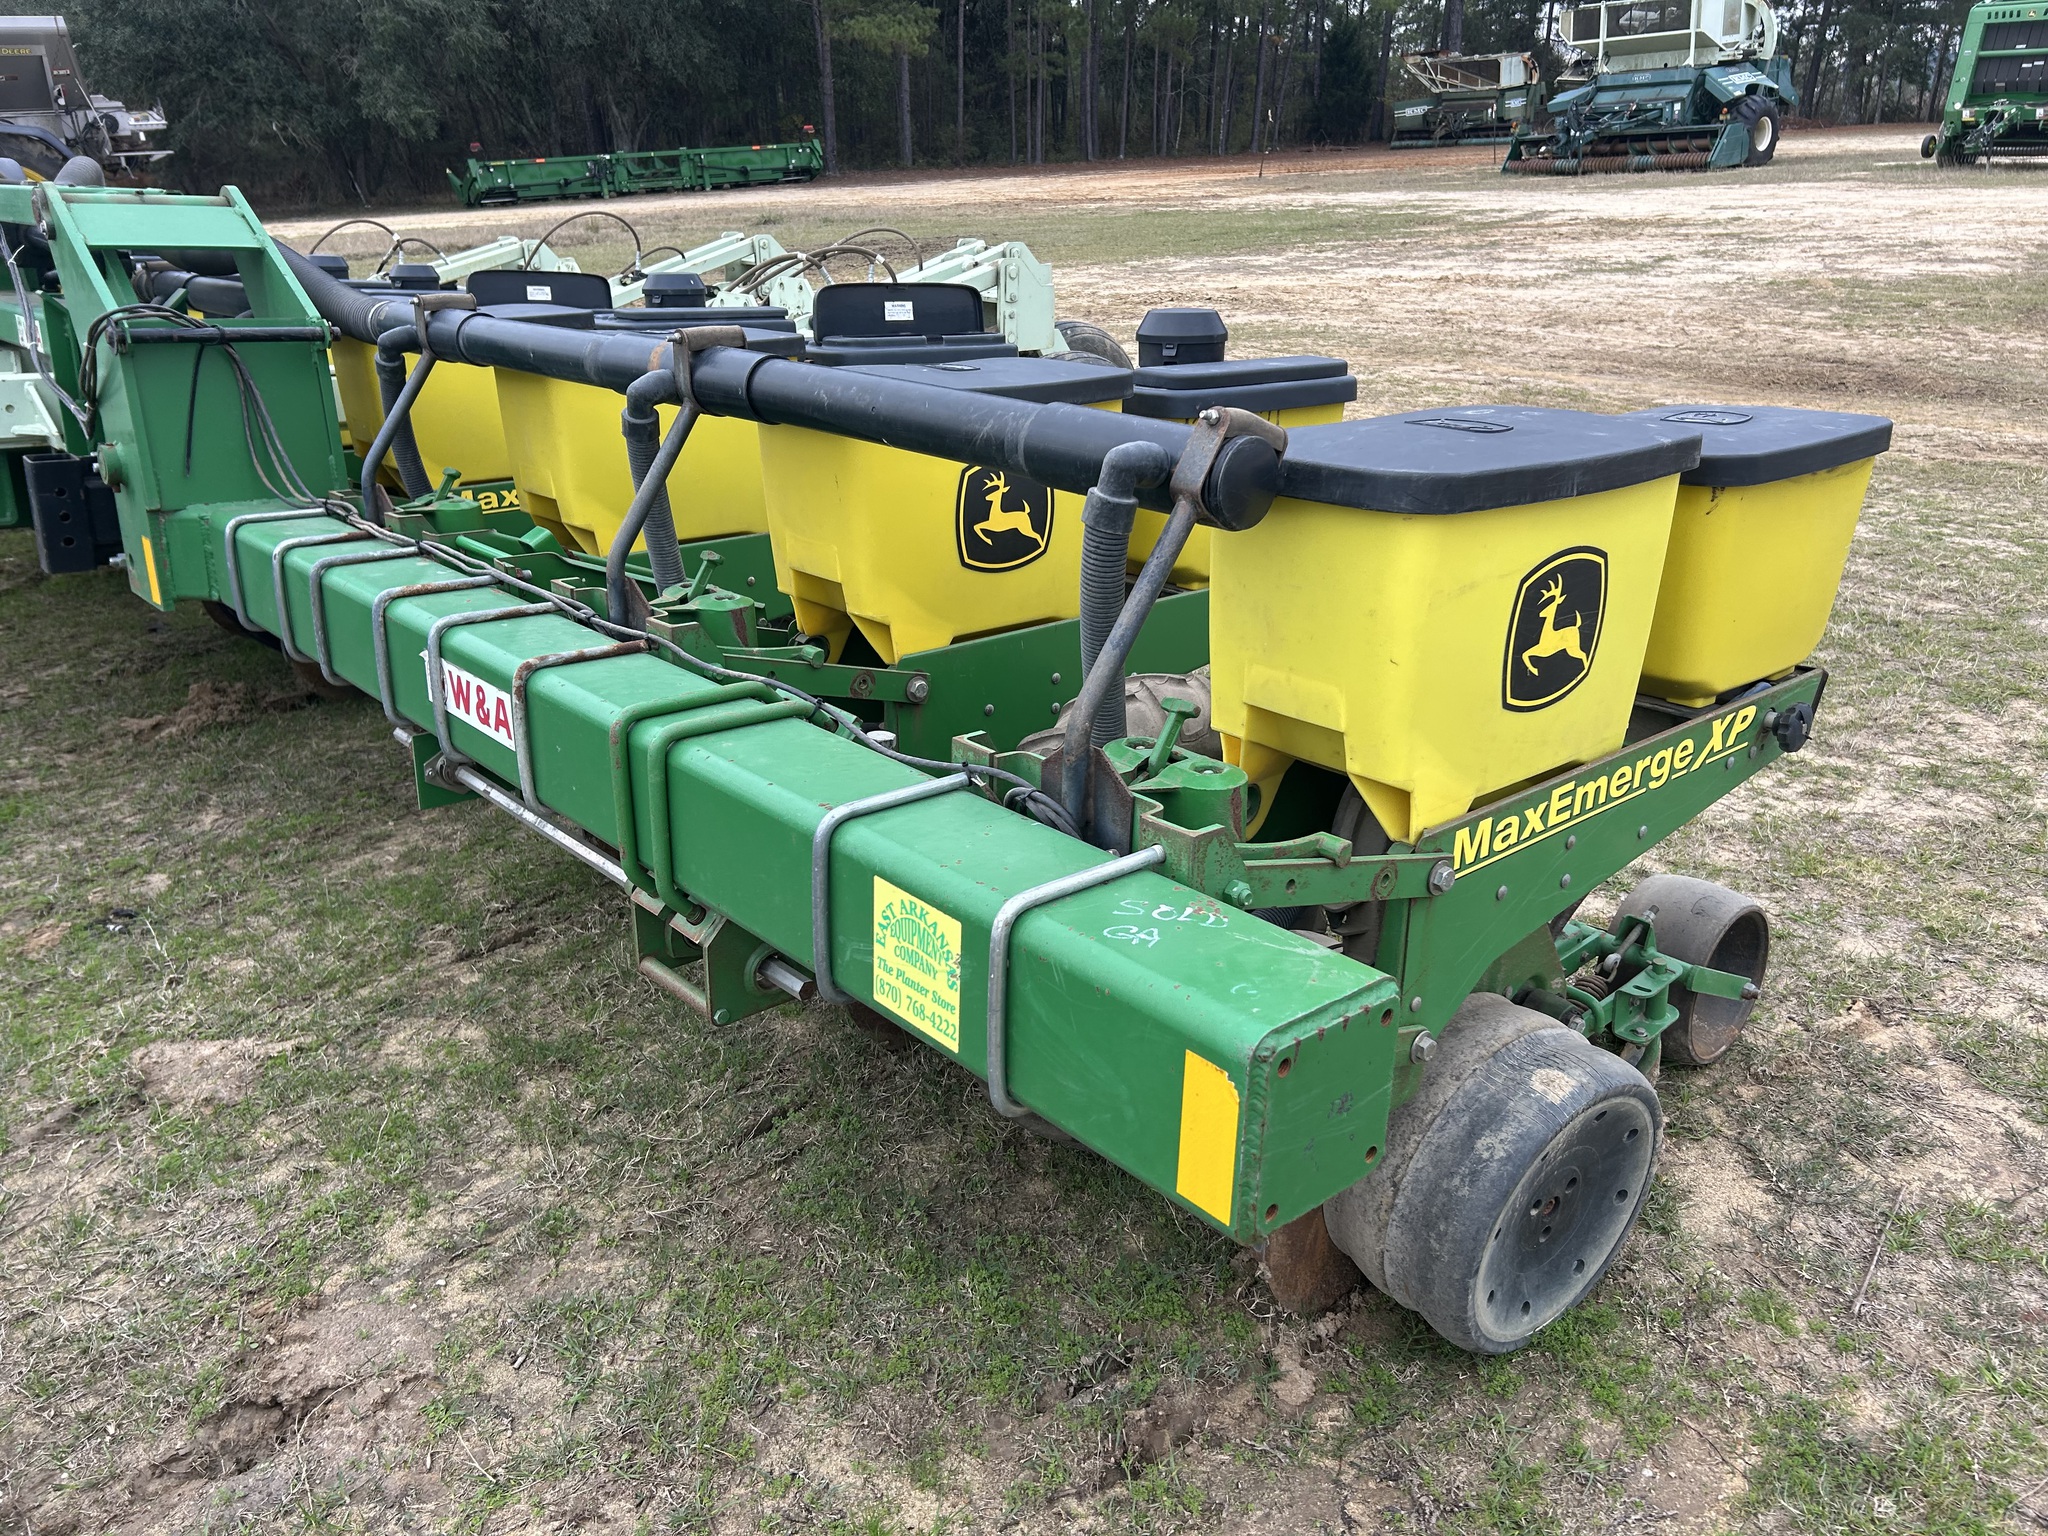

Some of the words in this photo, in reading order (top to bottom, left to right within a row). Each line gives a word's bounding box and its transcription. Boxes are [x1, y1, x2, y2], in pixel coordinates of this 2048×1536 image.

[447, 669, 513, 741] W&A
[1453, 737, 1695, 870] MaxEmerge
[1690, 704, 1758, 772] XP
[890, 917, 946, 967] EQUIPMENT
[1112, 900, 1229, 928] SOLD
[875, 901, 897, 950] EAST
[899, 899, 959, 993] ARKANSAS
[893, 945, 939, 981] COMPANY
[875, 974, 902, 1010] (870)
[906, 995, 958, 1042] 768-4222
[877, 956, 895, 977] The
[895, 967, 931, 998] Planter
[931, 990, 957, 1015] Store
